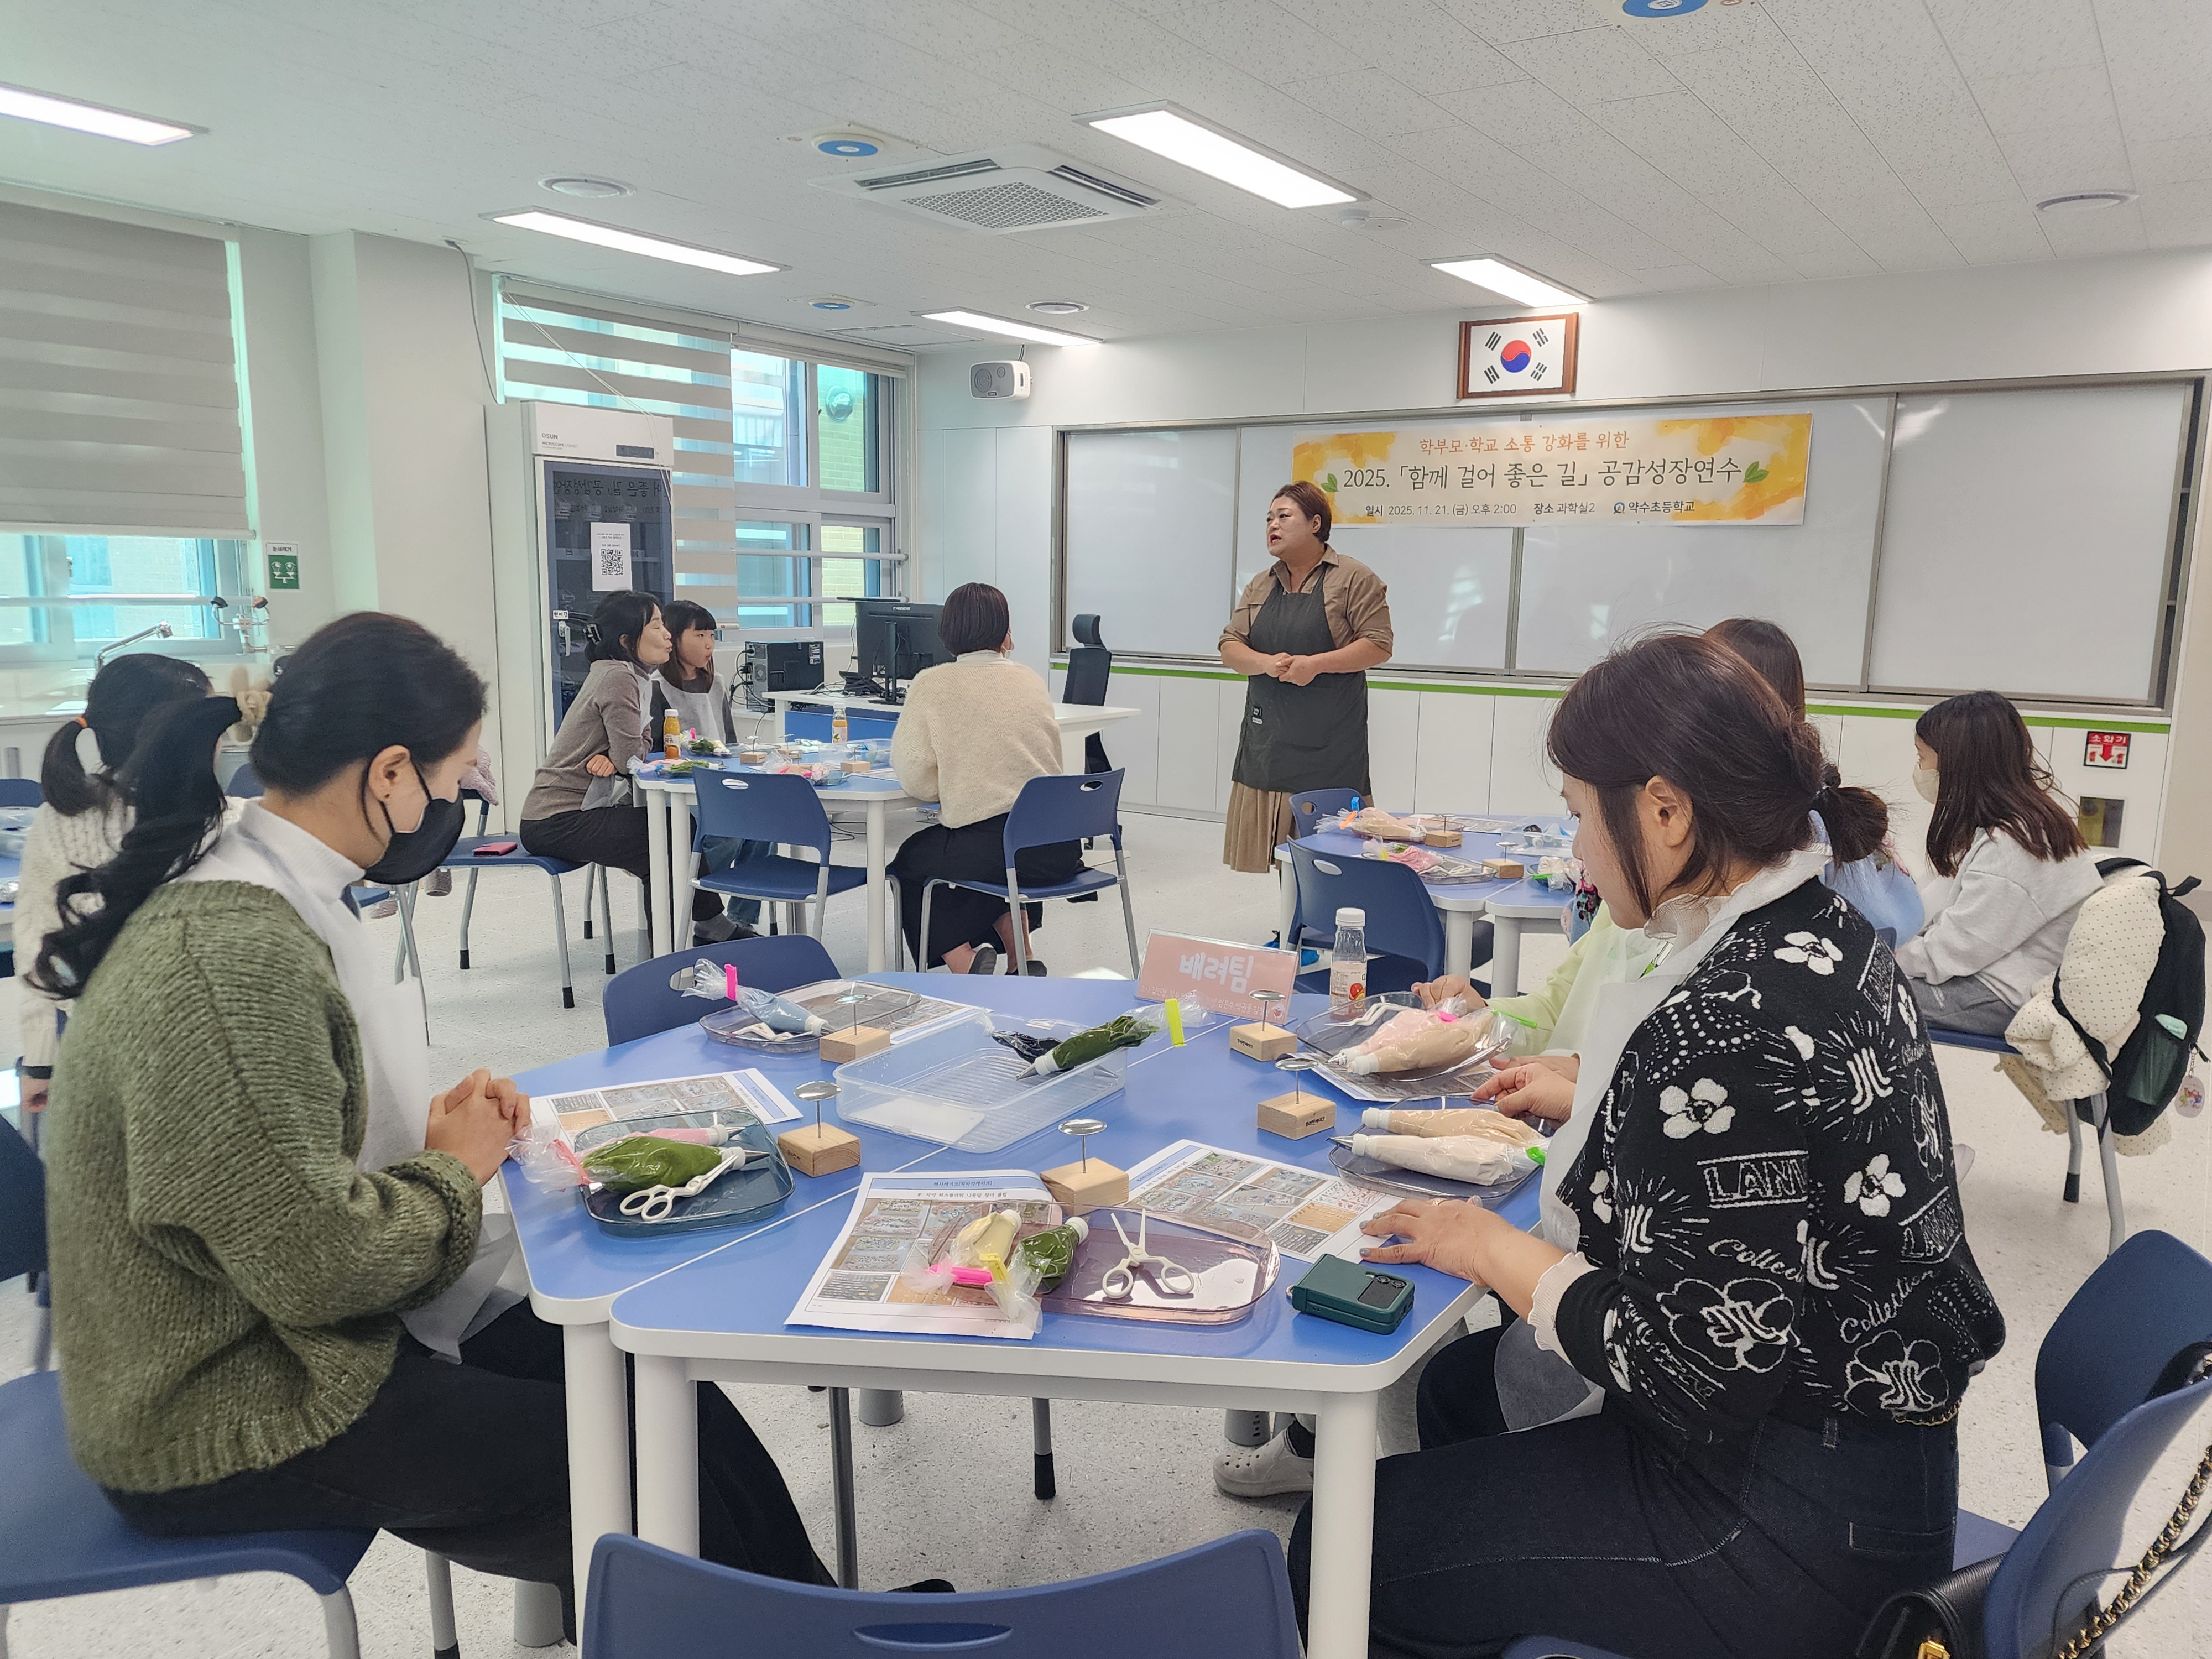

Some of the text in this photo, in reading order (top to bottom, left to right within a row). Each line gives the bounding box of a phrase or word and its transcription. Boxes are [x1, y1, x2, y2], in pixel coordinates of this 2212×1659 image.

[1420, 431, 1630, 455] 학부모·학교 소통 강화를 위한
[1343, 457, 1743, 491] 2025. 「함께 걸어 좋은 길」 공감성장연수
[1365, 501, 1595, 517] 일시 2025. 11. 21. (금) 오후 2:00 장소 과학실2
[1628, 501, 1695, 513] 약수초등학교
[2090, 734, 2127, 744] 소화기
[1178, 952, 1255, 994] 배려팀
[1839, 1269, 1937, 1343] Collection
